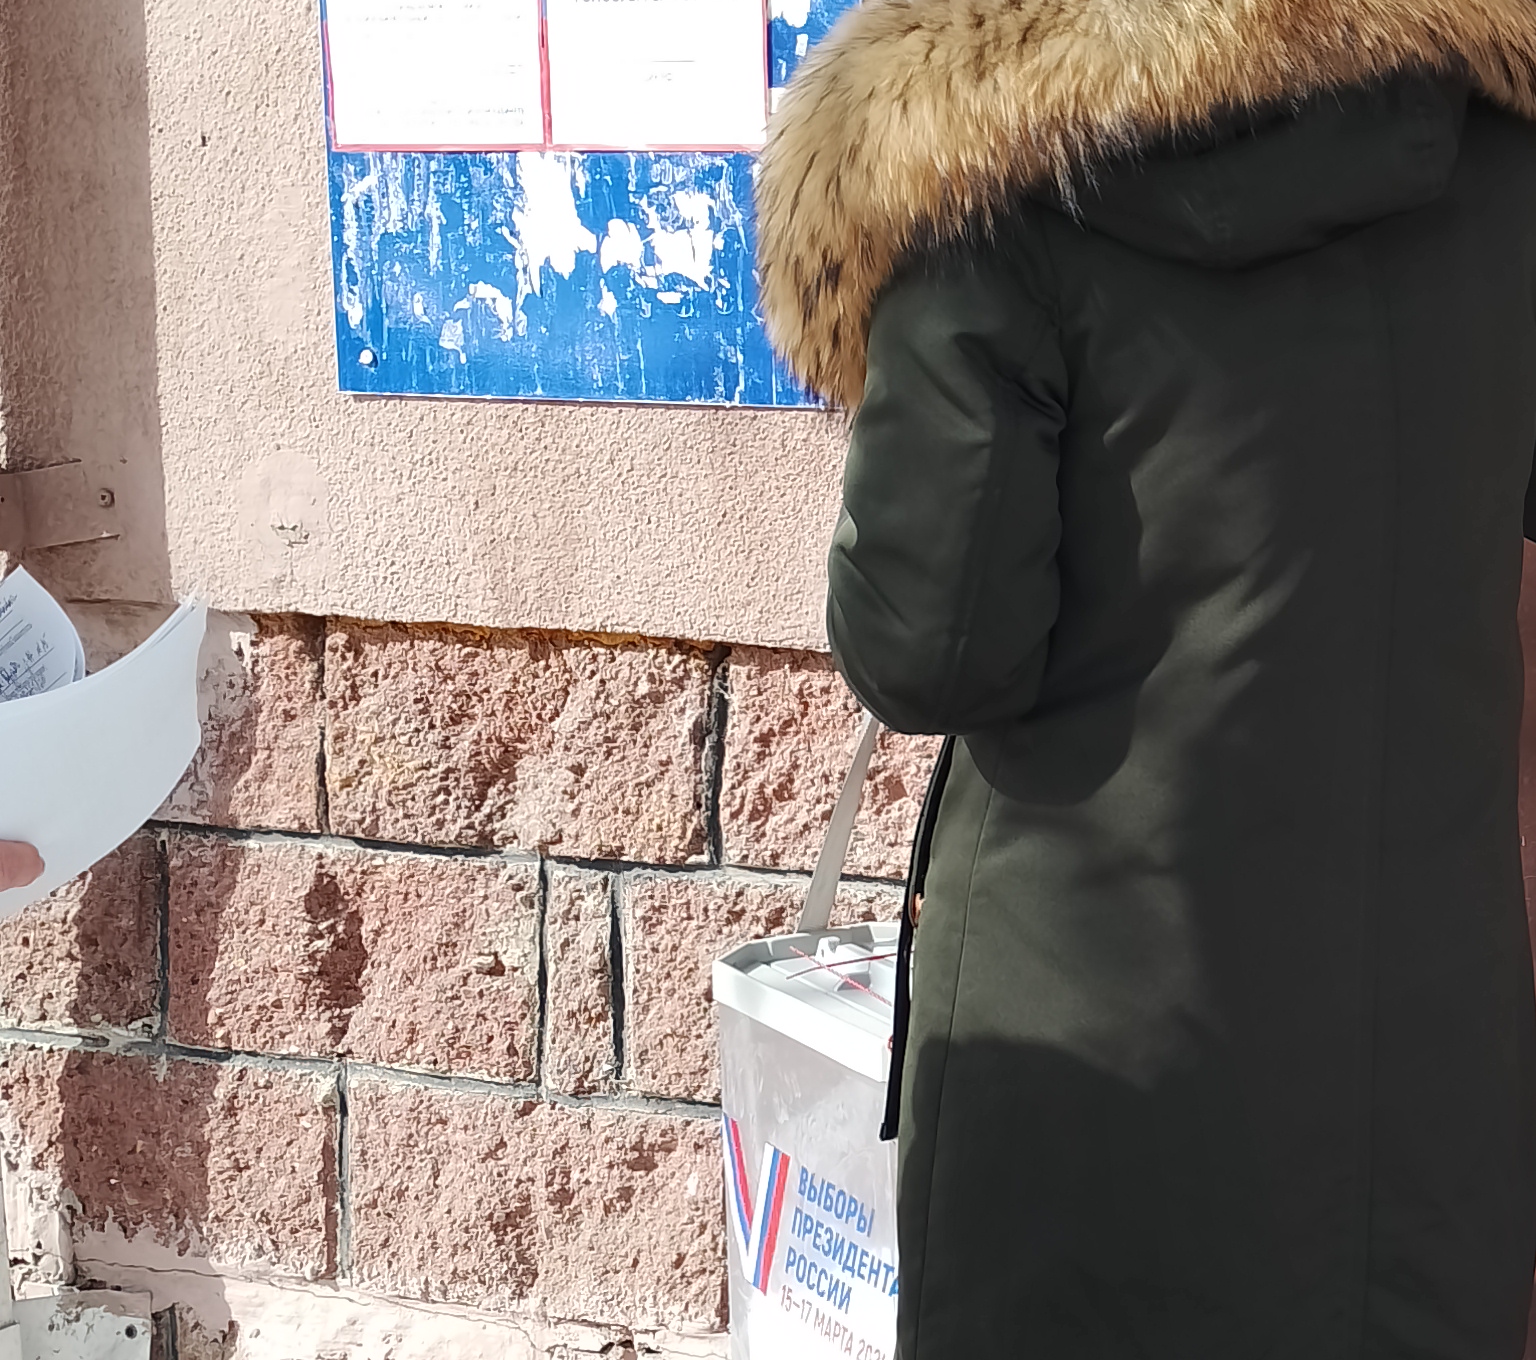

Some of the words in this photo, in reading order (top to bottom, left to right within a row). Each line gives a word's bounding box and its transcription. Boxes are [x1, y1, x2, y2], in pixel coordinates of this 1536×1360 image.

[797, 1165, 876, 1238] ВЫБОРЫ
[785, 1245, 853, 1315] РОССИИ
[790, 1206, 899, 1298] ПРЕЗИДЕНТА
[813, 1307, 854, 1357] МАРТА
